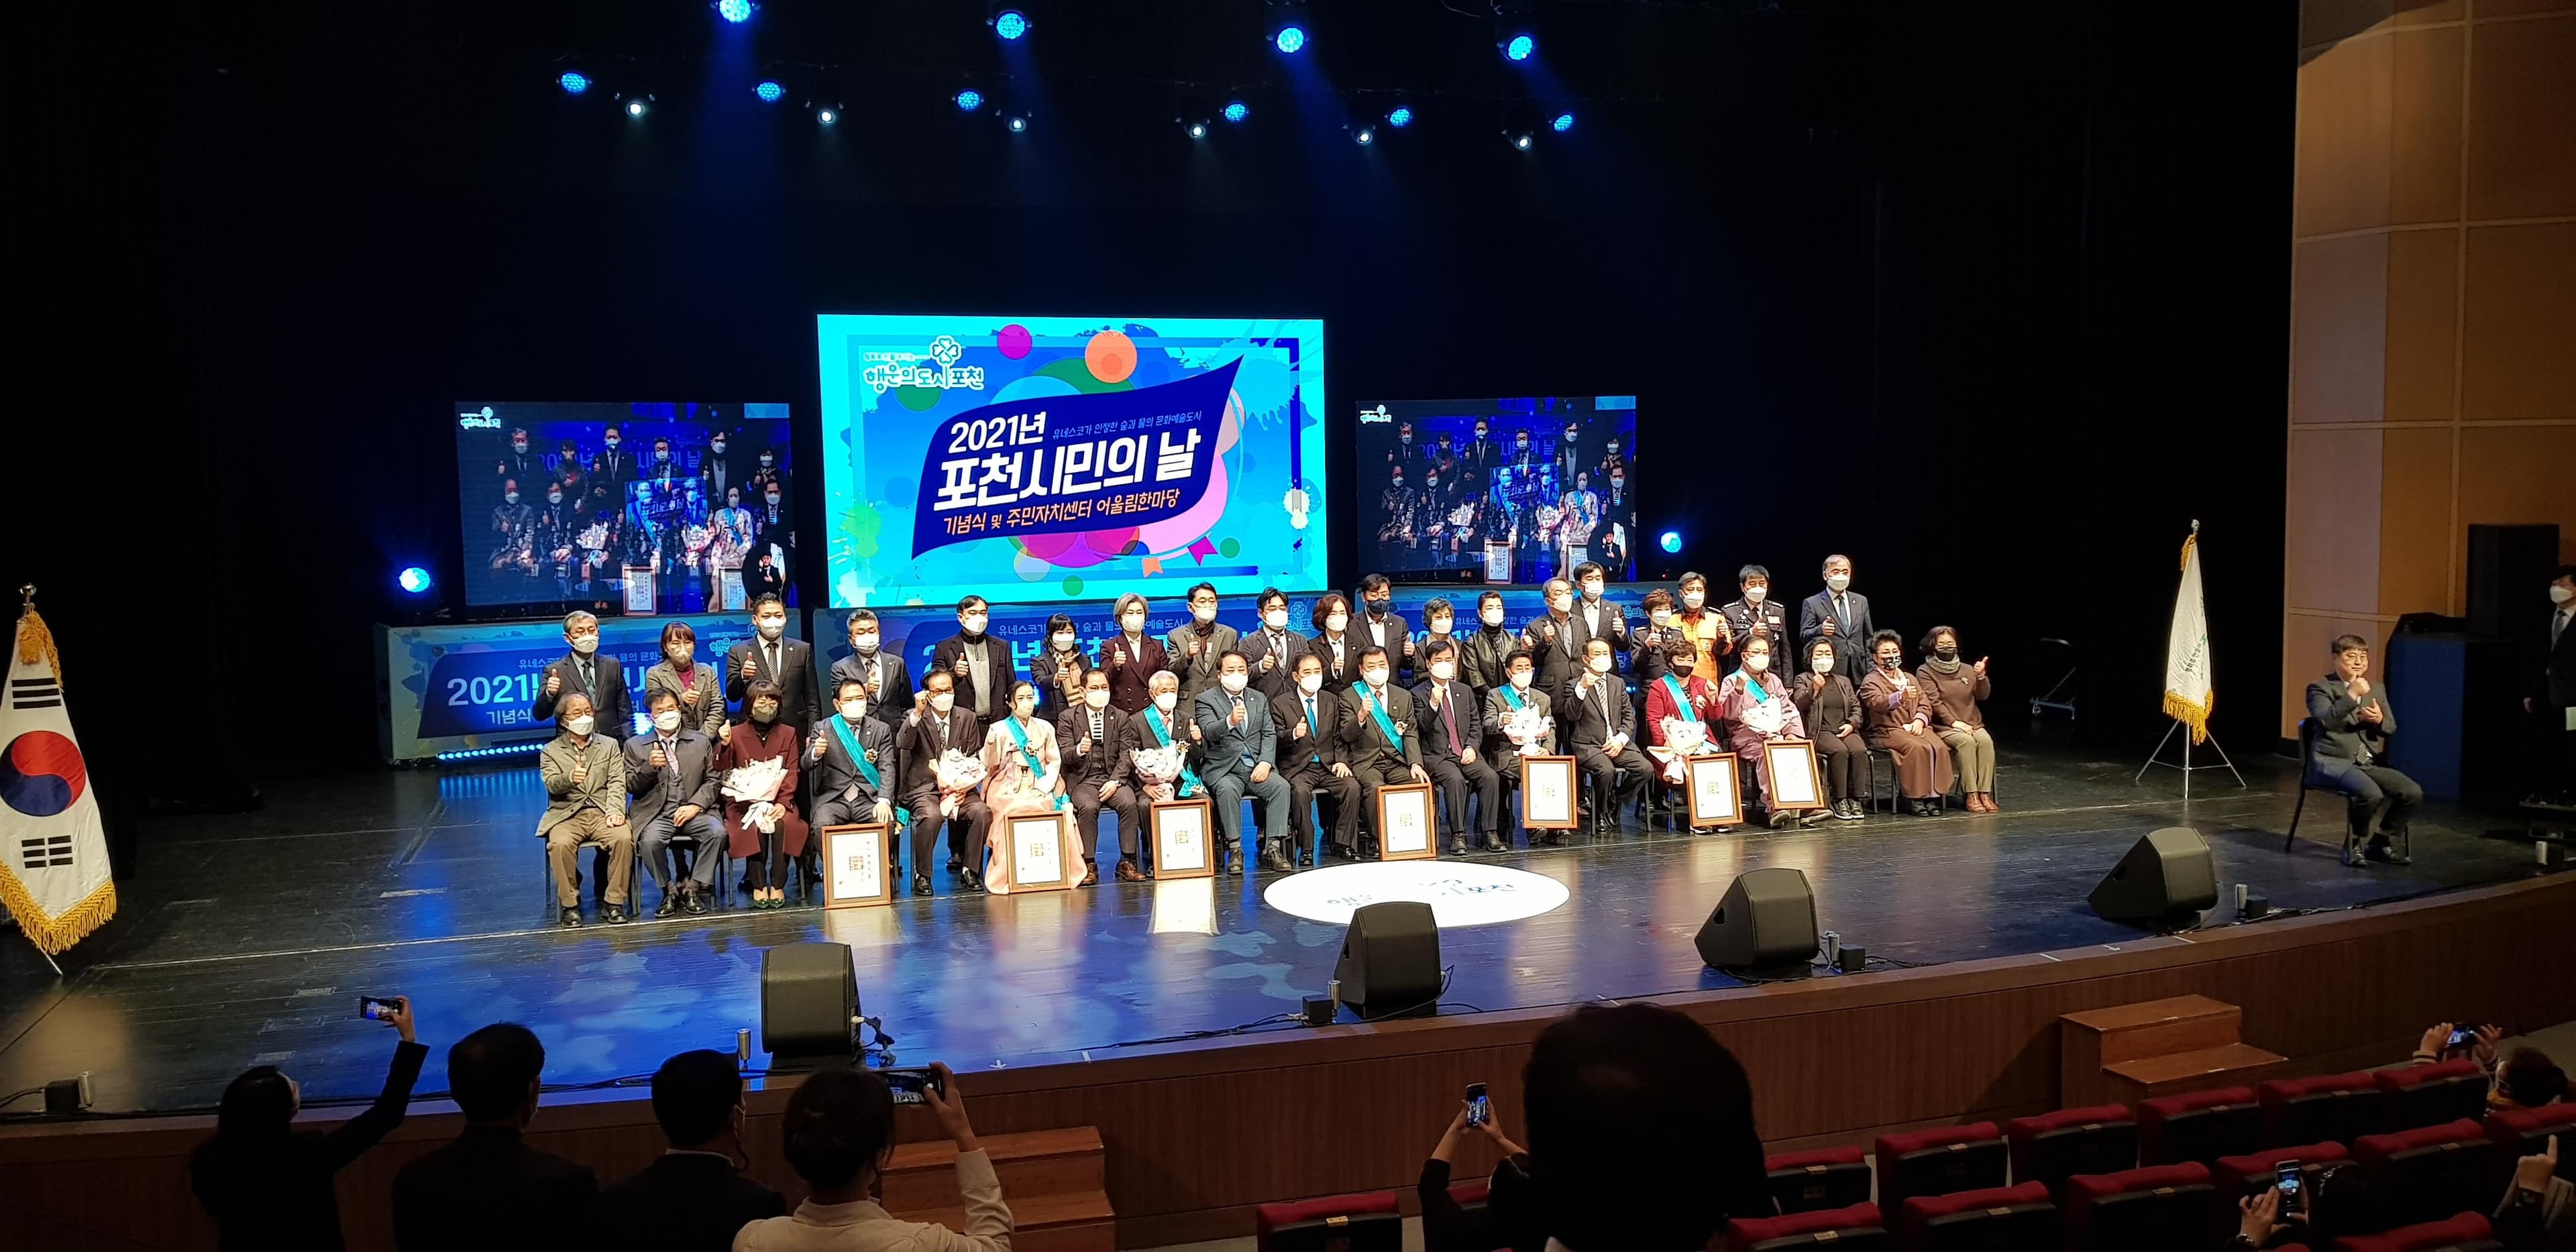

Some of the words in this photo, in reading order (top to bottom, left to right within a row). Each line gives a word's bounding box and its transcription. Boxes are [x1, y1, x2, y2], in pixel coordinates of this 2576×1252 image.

[948, 411, 1046, 454] 2021년
[1053, 424, 1093, 440] 유네스코가
[1094, 421, 1118, 434] 인정한
[1120, 418, 1136, 431] 숲과
[1138, 416, 1155, 429] 물의
[1155, 410, 1202, 426] 문화예술도시
[933, 433, 1149, 512] 포천시민의
[1155, 427, 1202, 482] 날
[943, 512, 987, 535] 기념식
[991, 514, 1002, 530] 및
[1006, 499, 1092, 527] 주민자치센터
[1096, 488, 1181, 516] 어울림한마당
[1082, 622, 1102, 632] 숲과
[486, 708, 531, 725] 기념식
